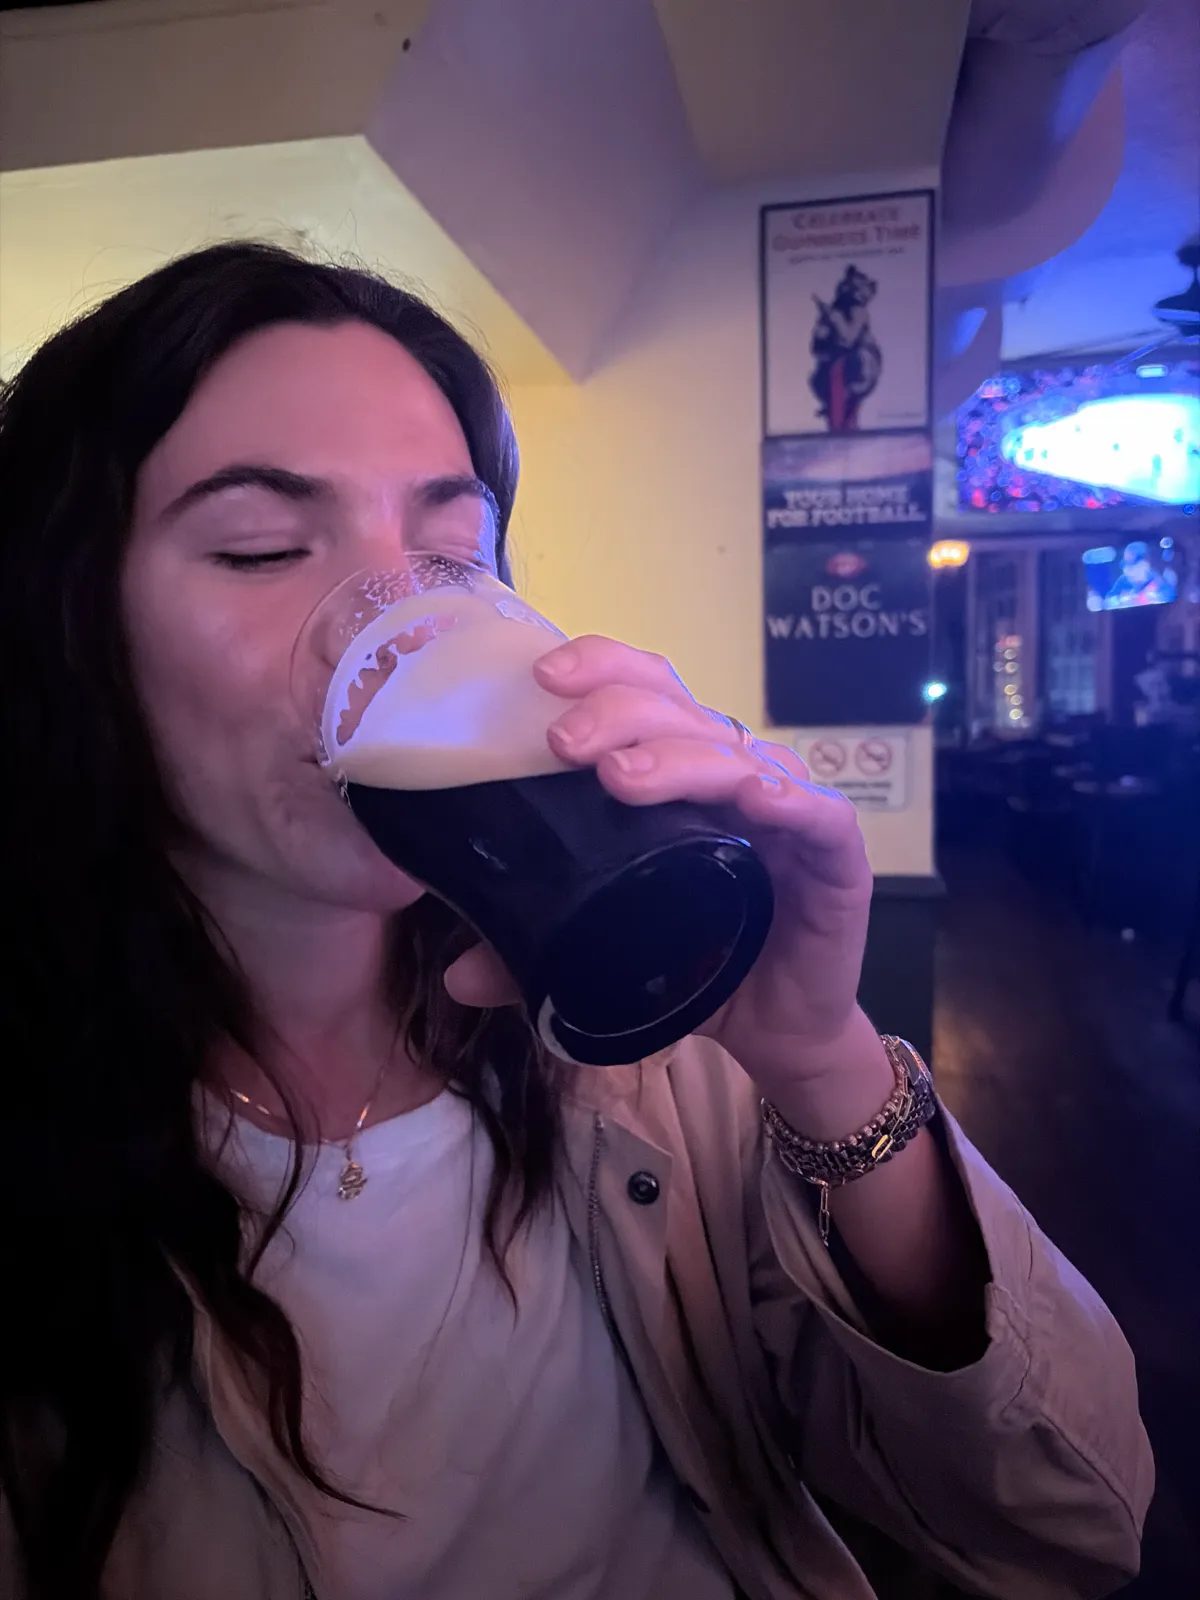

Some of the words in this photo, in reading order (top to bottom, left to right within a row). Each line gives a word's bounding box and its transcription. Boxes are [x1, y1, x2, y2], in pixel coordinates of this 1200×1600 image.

[767, 509, 809, 529] FOR
[811, 584, 880, 612] DOC
[766, 609, 927, 639] WATSON'S
